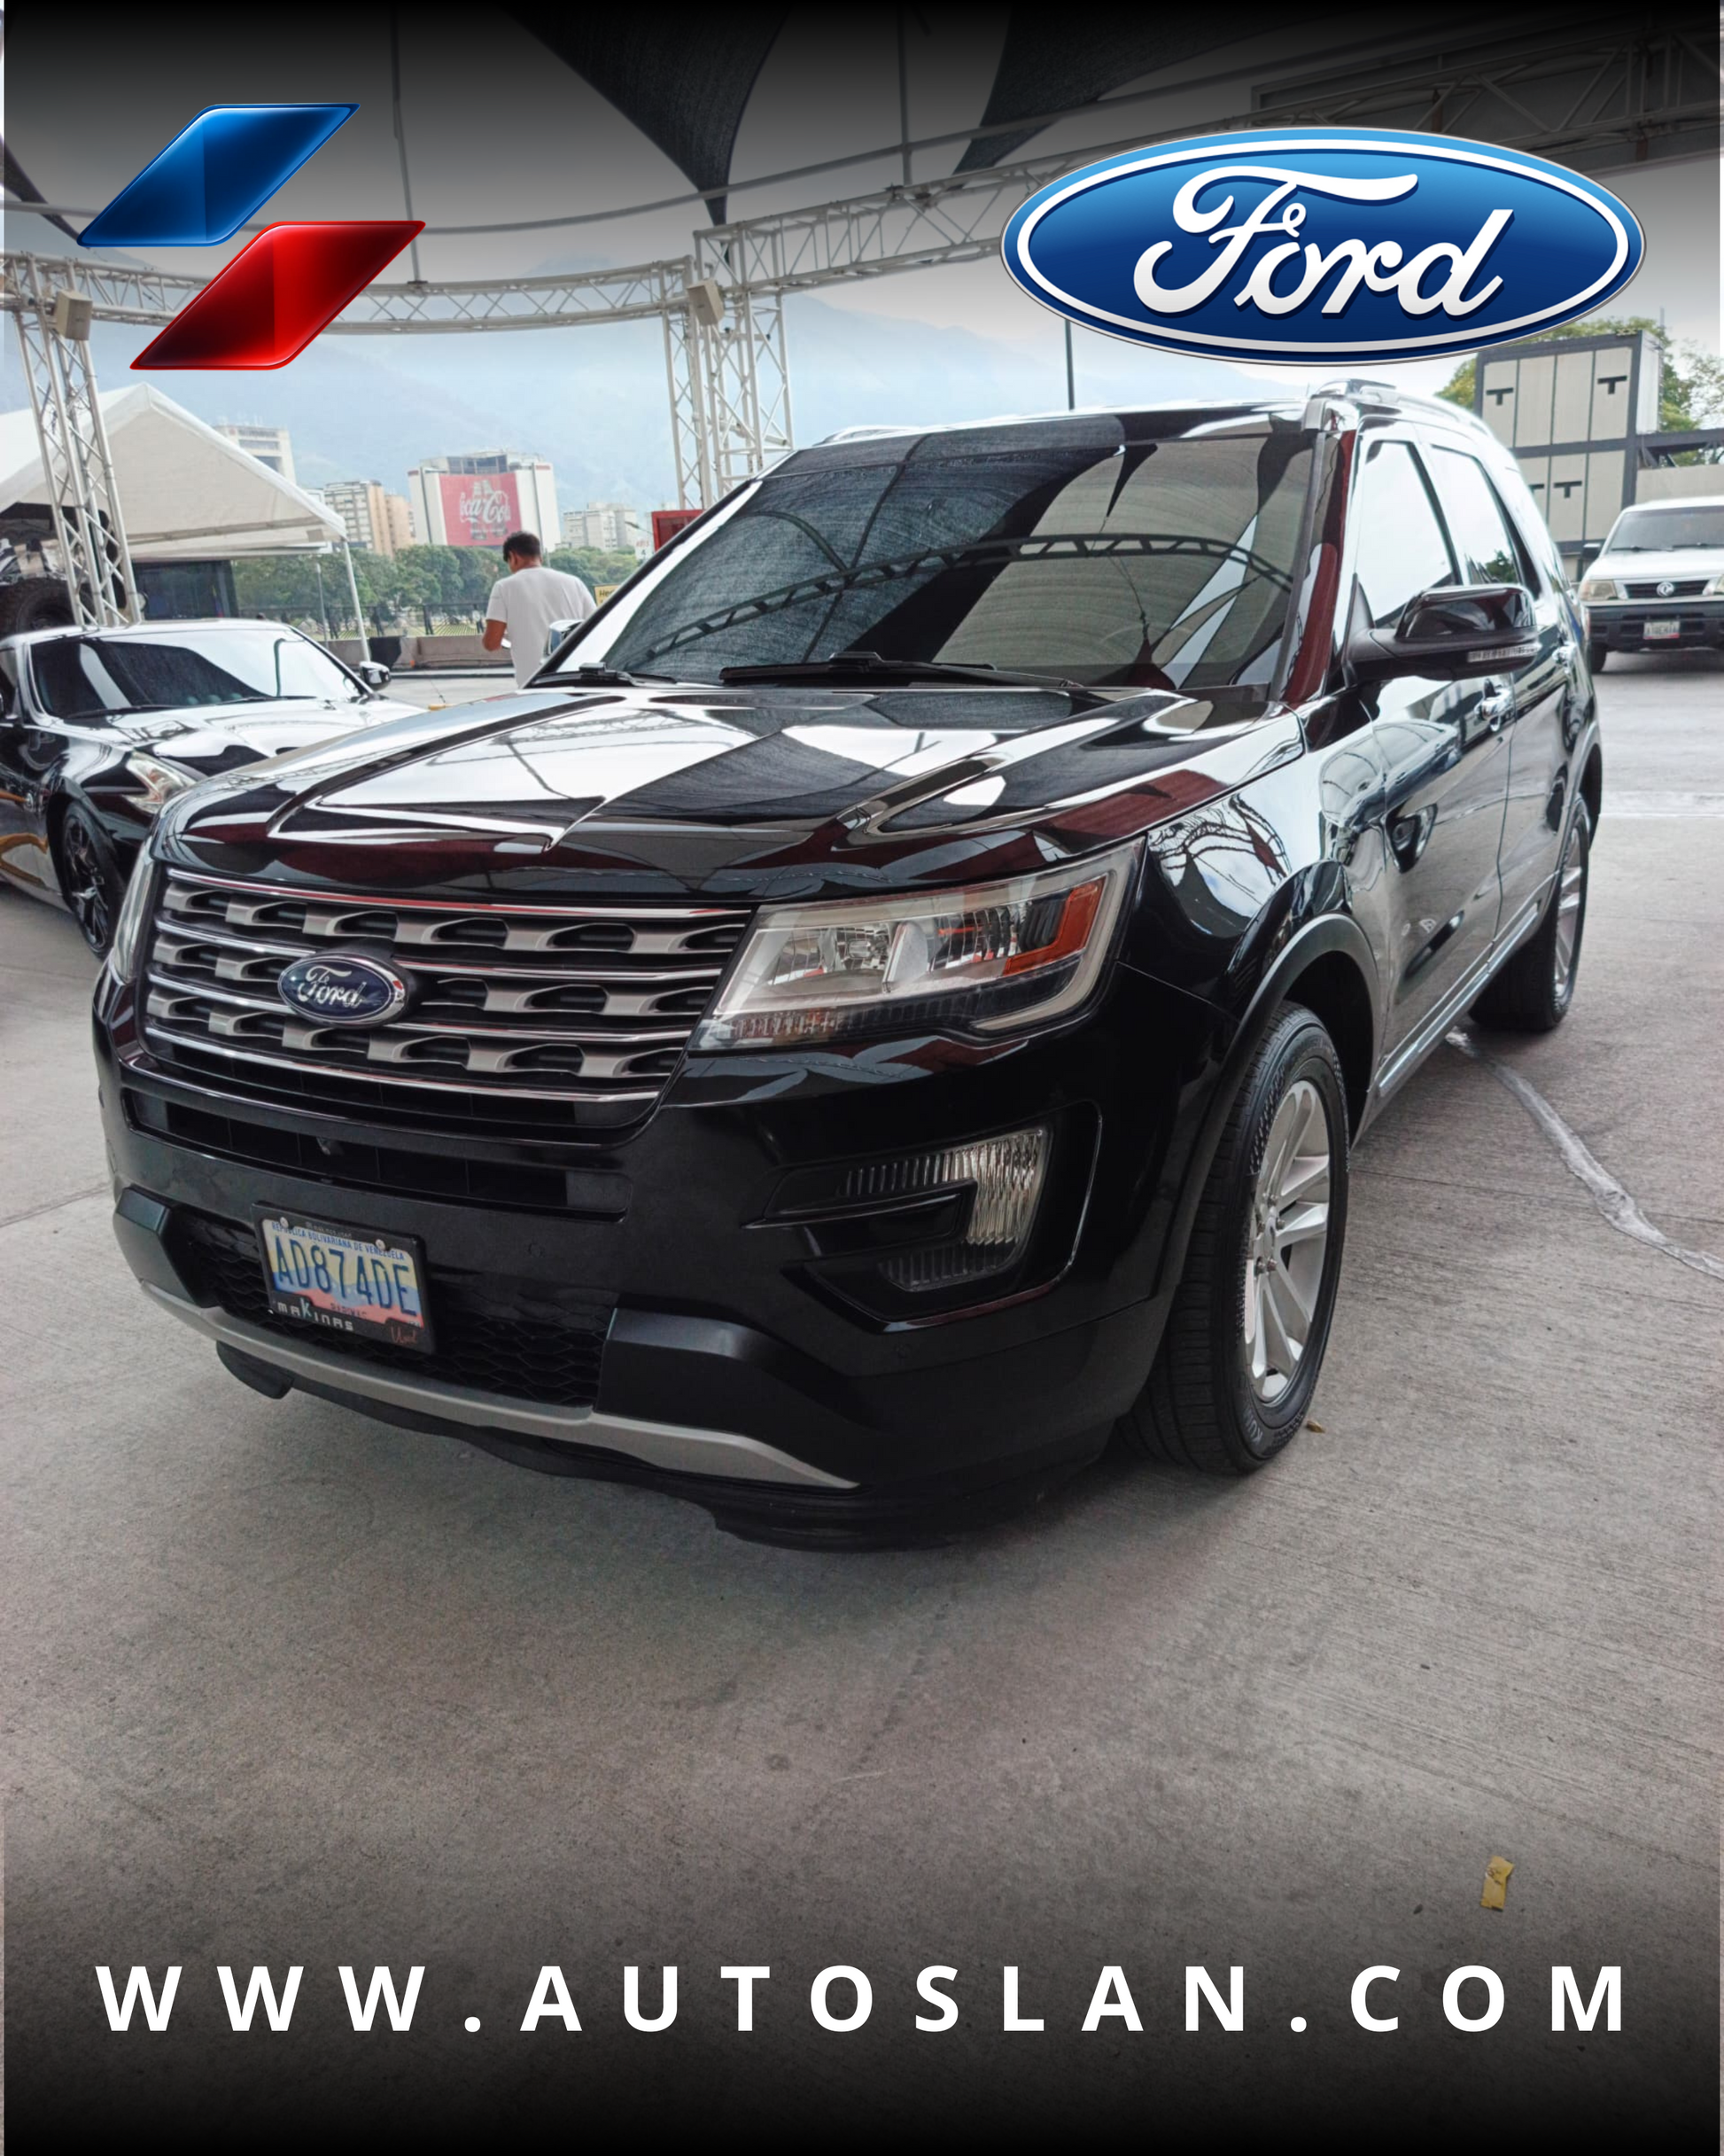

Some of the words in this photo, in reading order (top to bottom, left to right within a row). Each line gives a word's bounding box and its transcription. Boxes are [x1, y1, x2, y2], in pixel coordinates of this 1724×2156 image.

[295, 965, 367, 1008] Ford
[307, 1232, 352, 1249] BOLIVARIANA
[353, 1241, 364, 1252] DE
[274, 1234, 417, 1317] AD874DE
